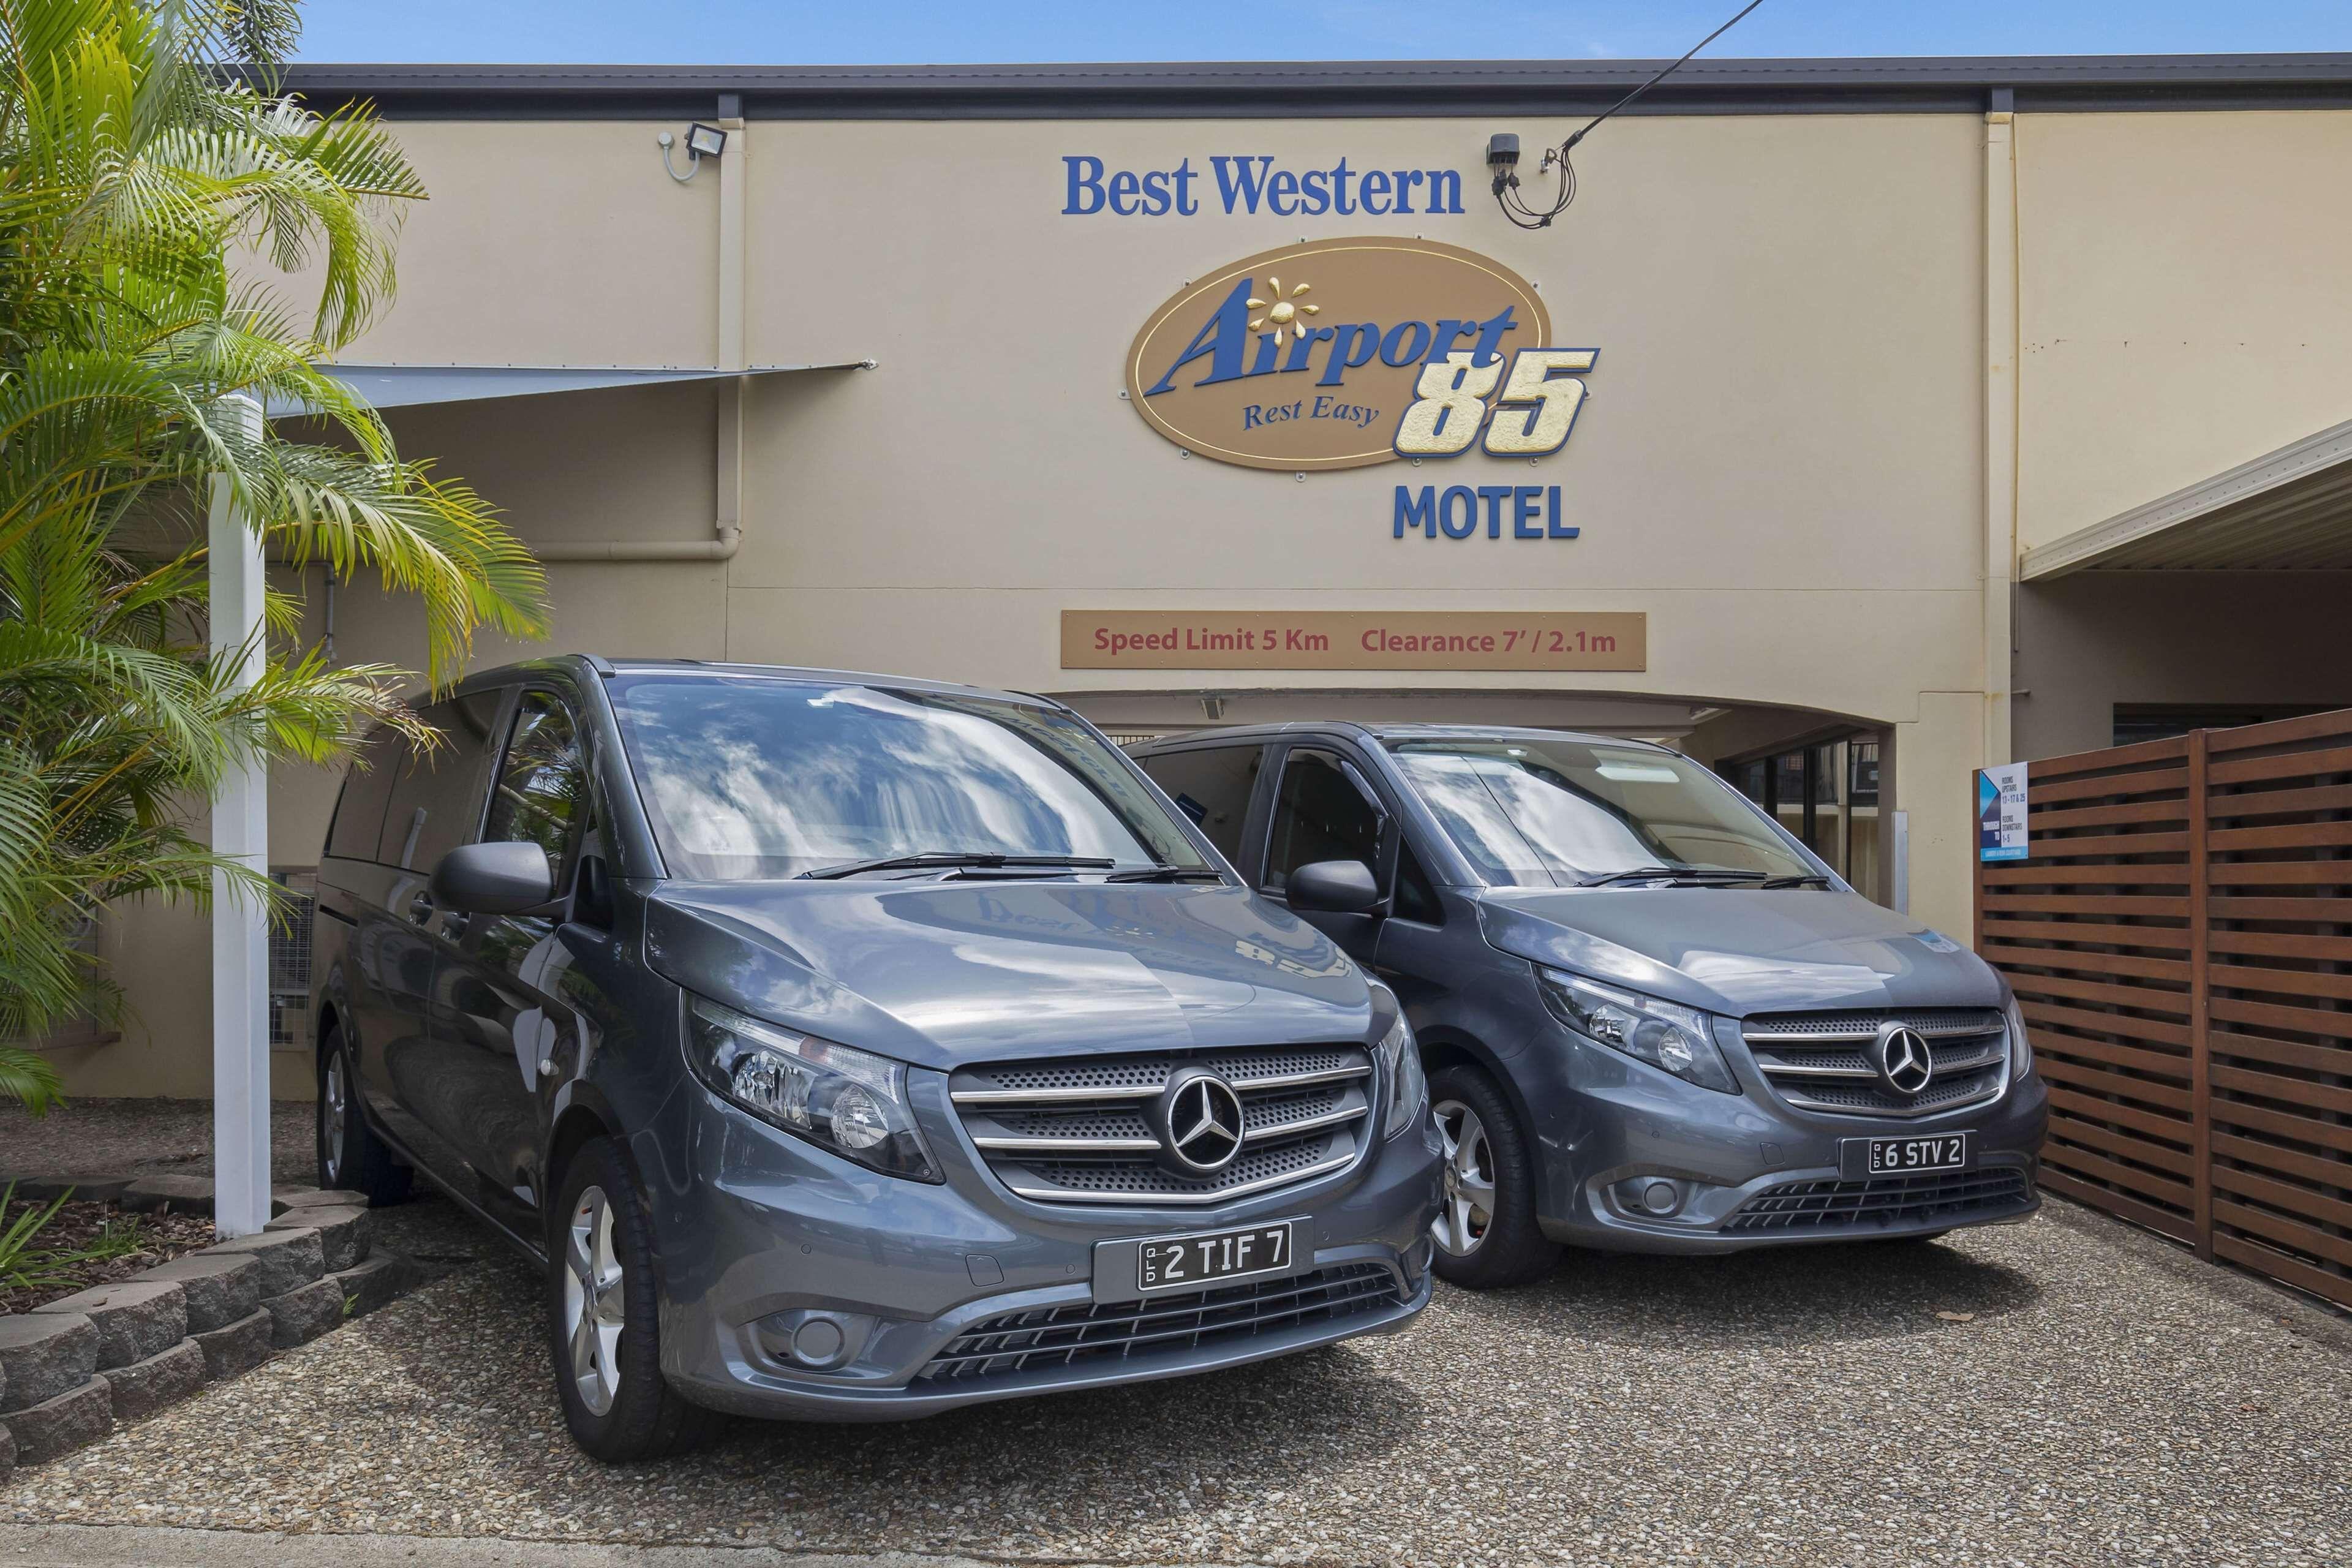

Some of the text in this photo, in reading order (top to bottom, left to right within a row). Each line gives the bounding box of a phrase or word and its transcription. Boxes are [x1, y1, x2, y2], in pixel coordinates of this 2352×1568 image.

[1061, 156, 1466, 216] Best Western
[1144, 277, 1518, 398] Airport
[1242, 396, 1379, 431] Rest Easy
[1392, 347, 1601, 458] 85
[1393, 485, 1580, 539] MOTEL
[1095, 627, 1178, 655] Speed
[1186, 628, 1254, 650] Limit
[1262, 630, 1277, 650] 5
[1286, 629, 1329, 650] Km
[1361, 629, 1494, 652] Clearance
[1548, 631, 1616, 652] 2.1m
[1885, 1139, 1959, 1166] 6 STV 2
[1146, 1248, 1156, 1282] QLD
[1165, 1230, 1283, 1279] 2 TIF 7
